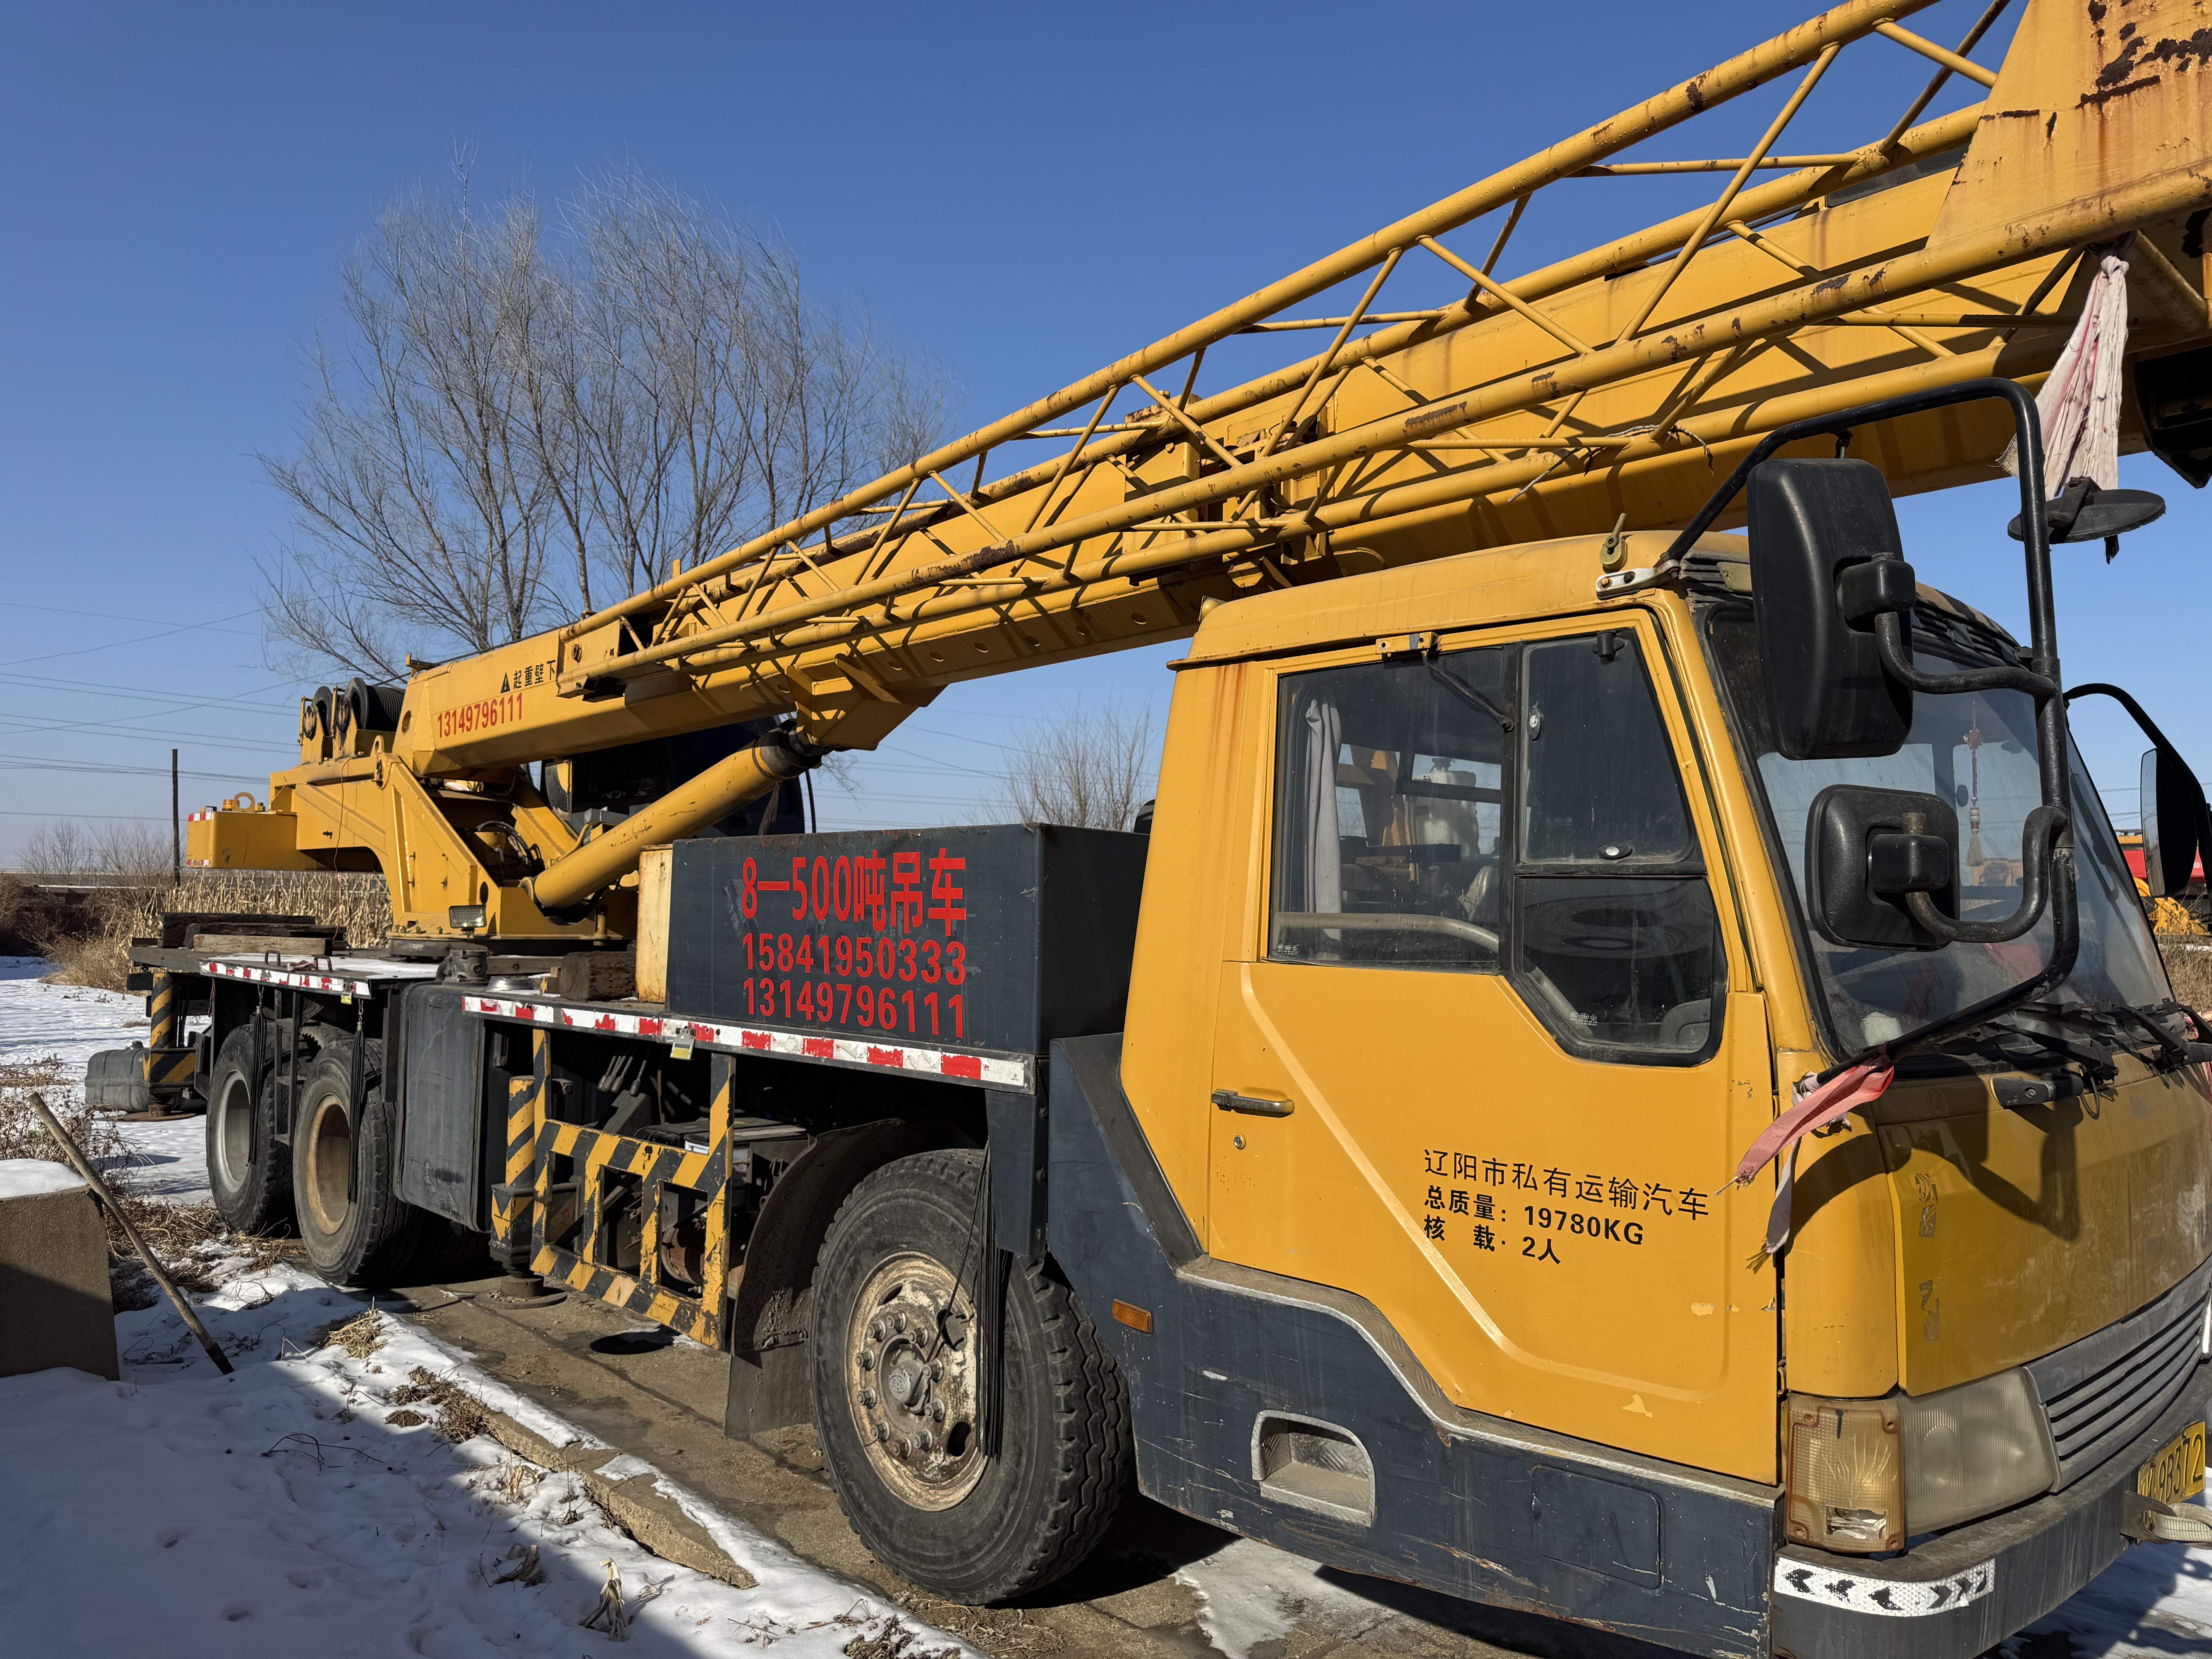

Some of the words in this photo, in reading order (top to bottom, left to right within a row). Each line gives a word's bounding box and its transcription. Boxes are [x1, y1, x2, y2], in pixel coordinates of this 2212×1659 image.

[437, 693, 522, 738] 13149796111
[743, 933, 967, 986] 15841950333
[744, 978, 963, 1038] 13149796111
[1424, 1149, 1709, 1221] 辽阳市私有运输汽车
[1424, 1185, 1506, 1222] 总质量：
[1524, 1205, 1644, 1245] 19780KG
[1522, 1236, 1561, 1265] 2人
